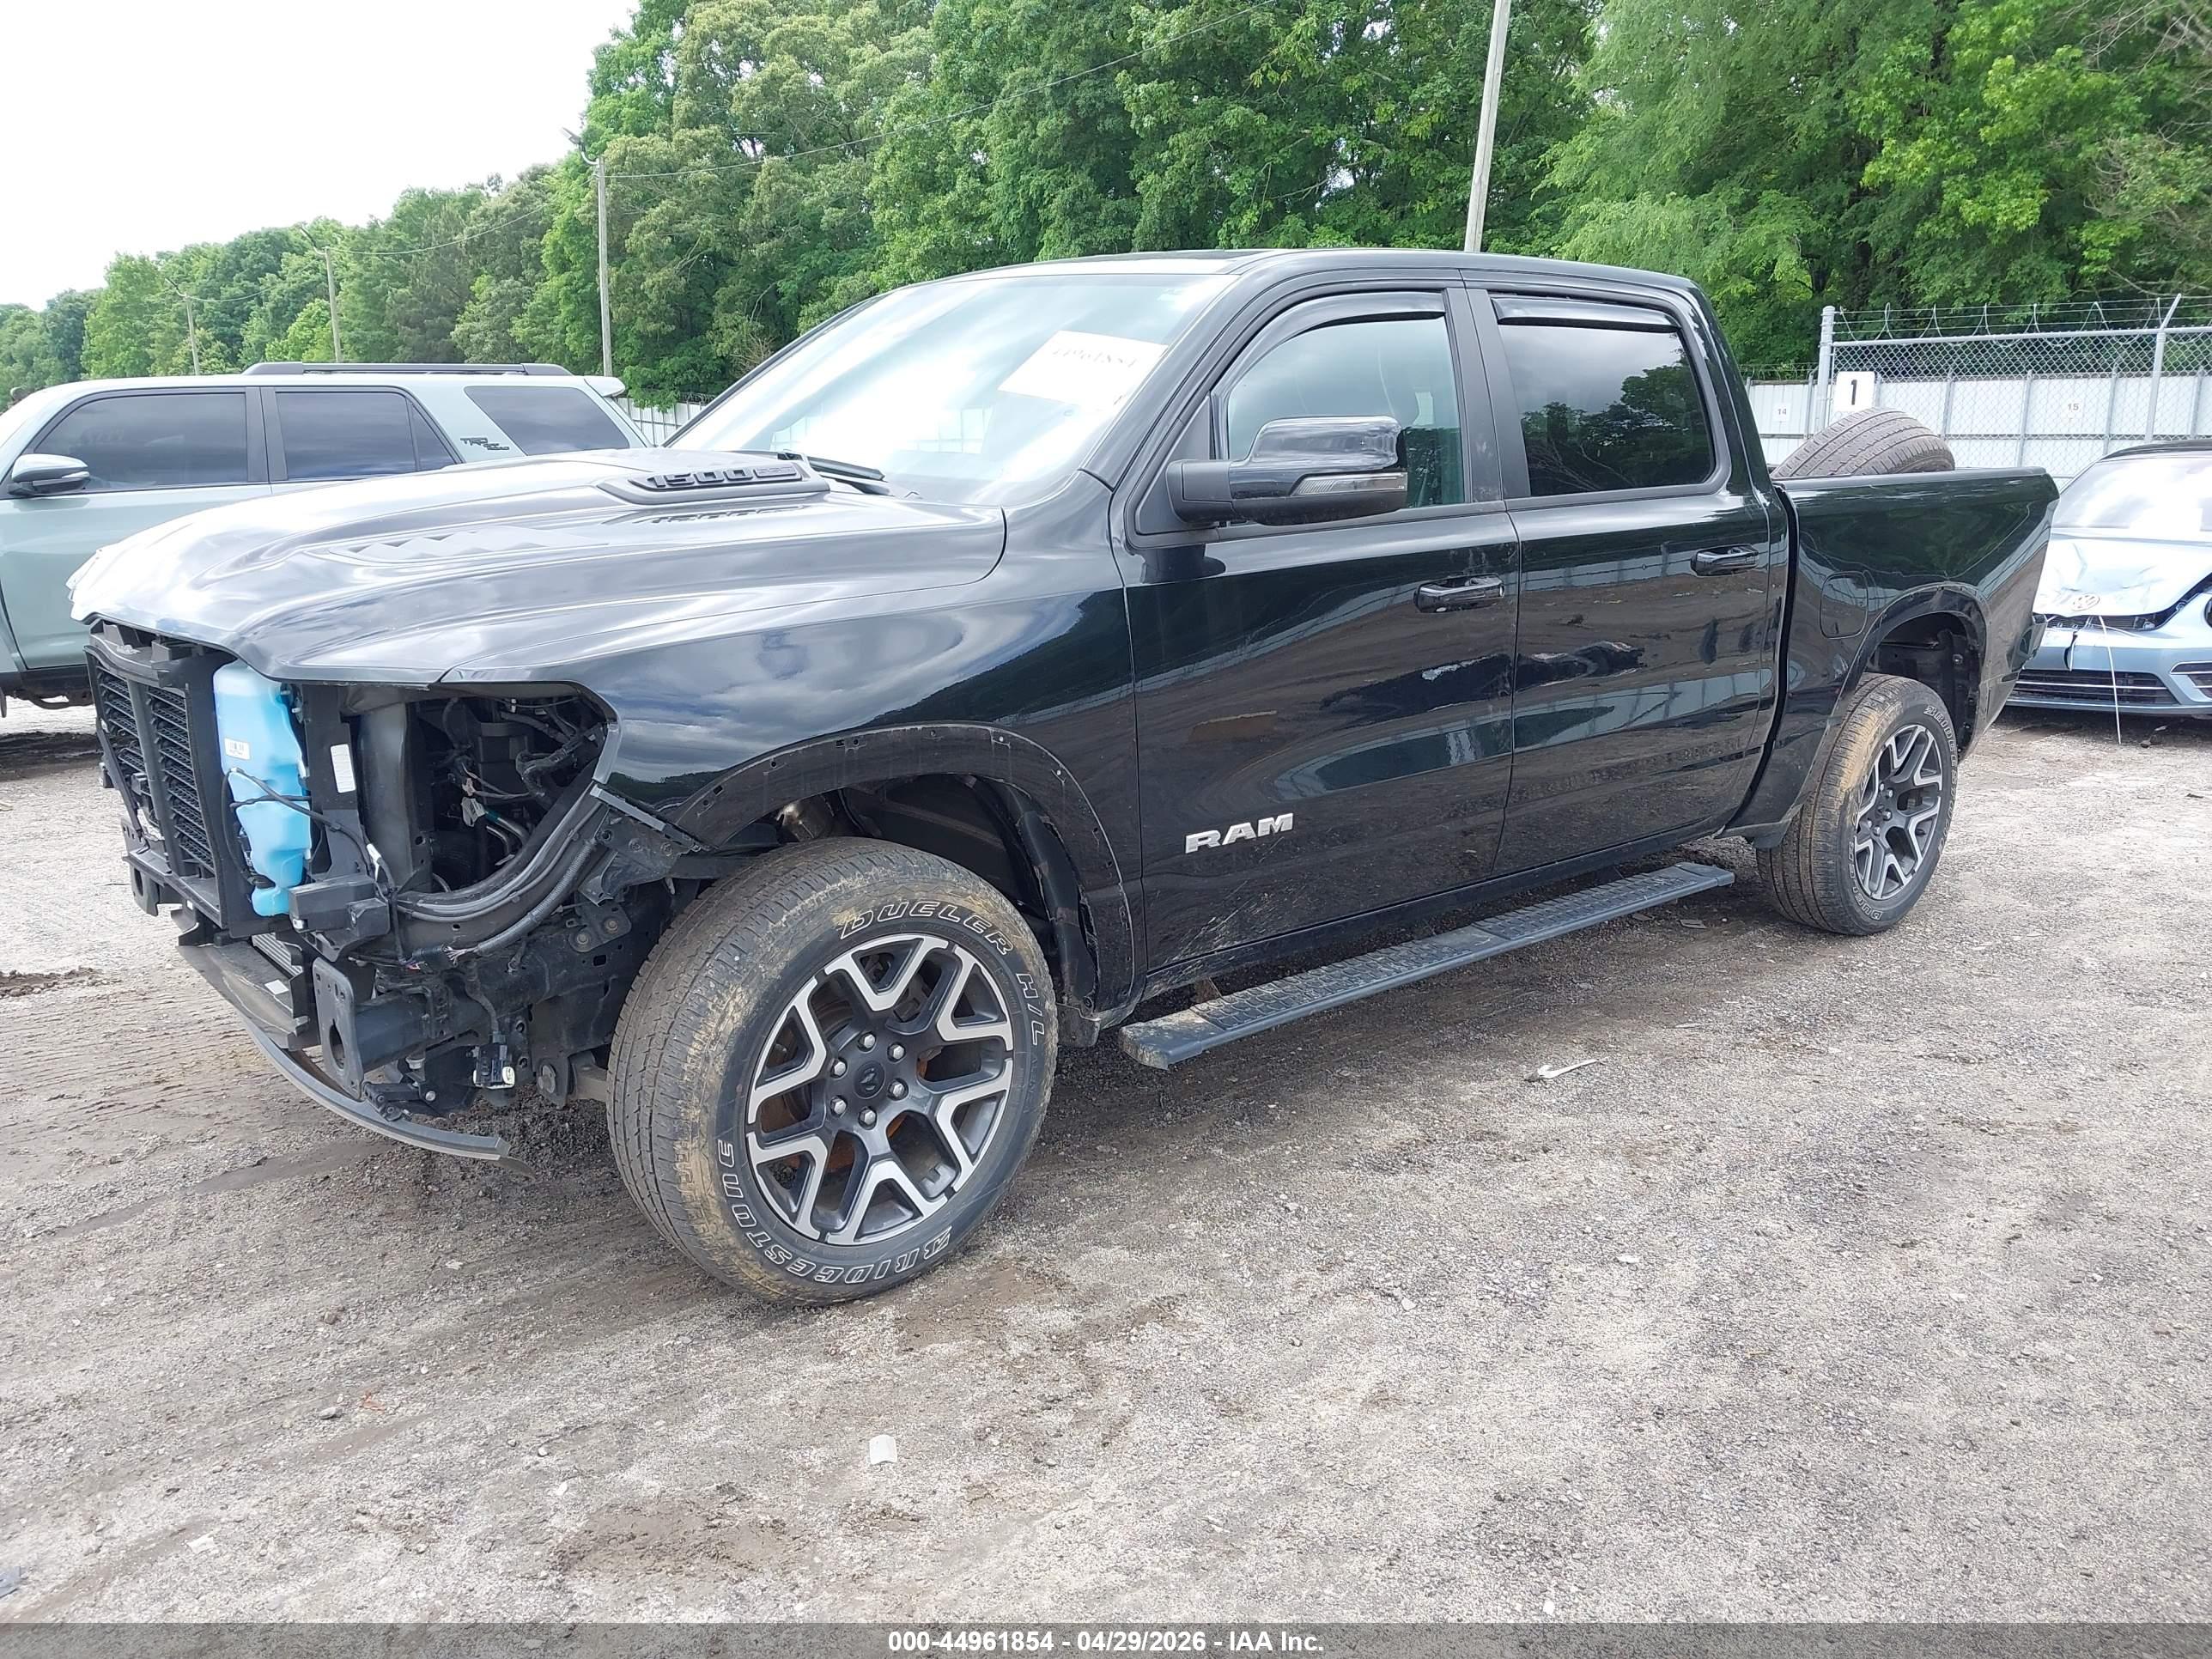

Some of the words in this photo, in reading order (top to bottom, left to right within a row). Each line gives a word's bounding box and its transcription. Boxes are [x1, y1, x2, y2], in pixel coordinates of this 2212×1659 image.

[1850, 379, 1857, 405] 1
[2067, 403, 2080, 411] 15
[647, 468, 753, 488] 1500
[1185, 812, 1294, 854] RAM
[840, 902, 1014, 955] DUELER
[1016, 973, 1045, 1046] H/L
[717, 1139, 953, 1284] BRIDGESTONE
